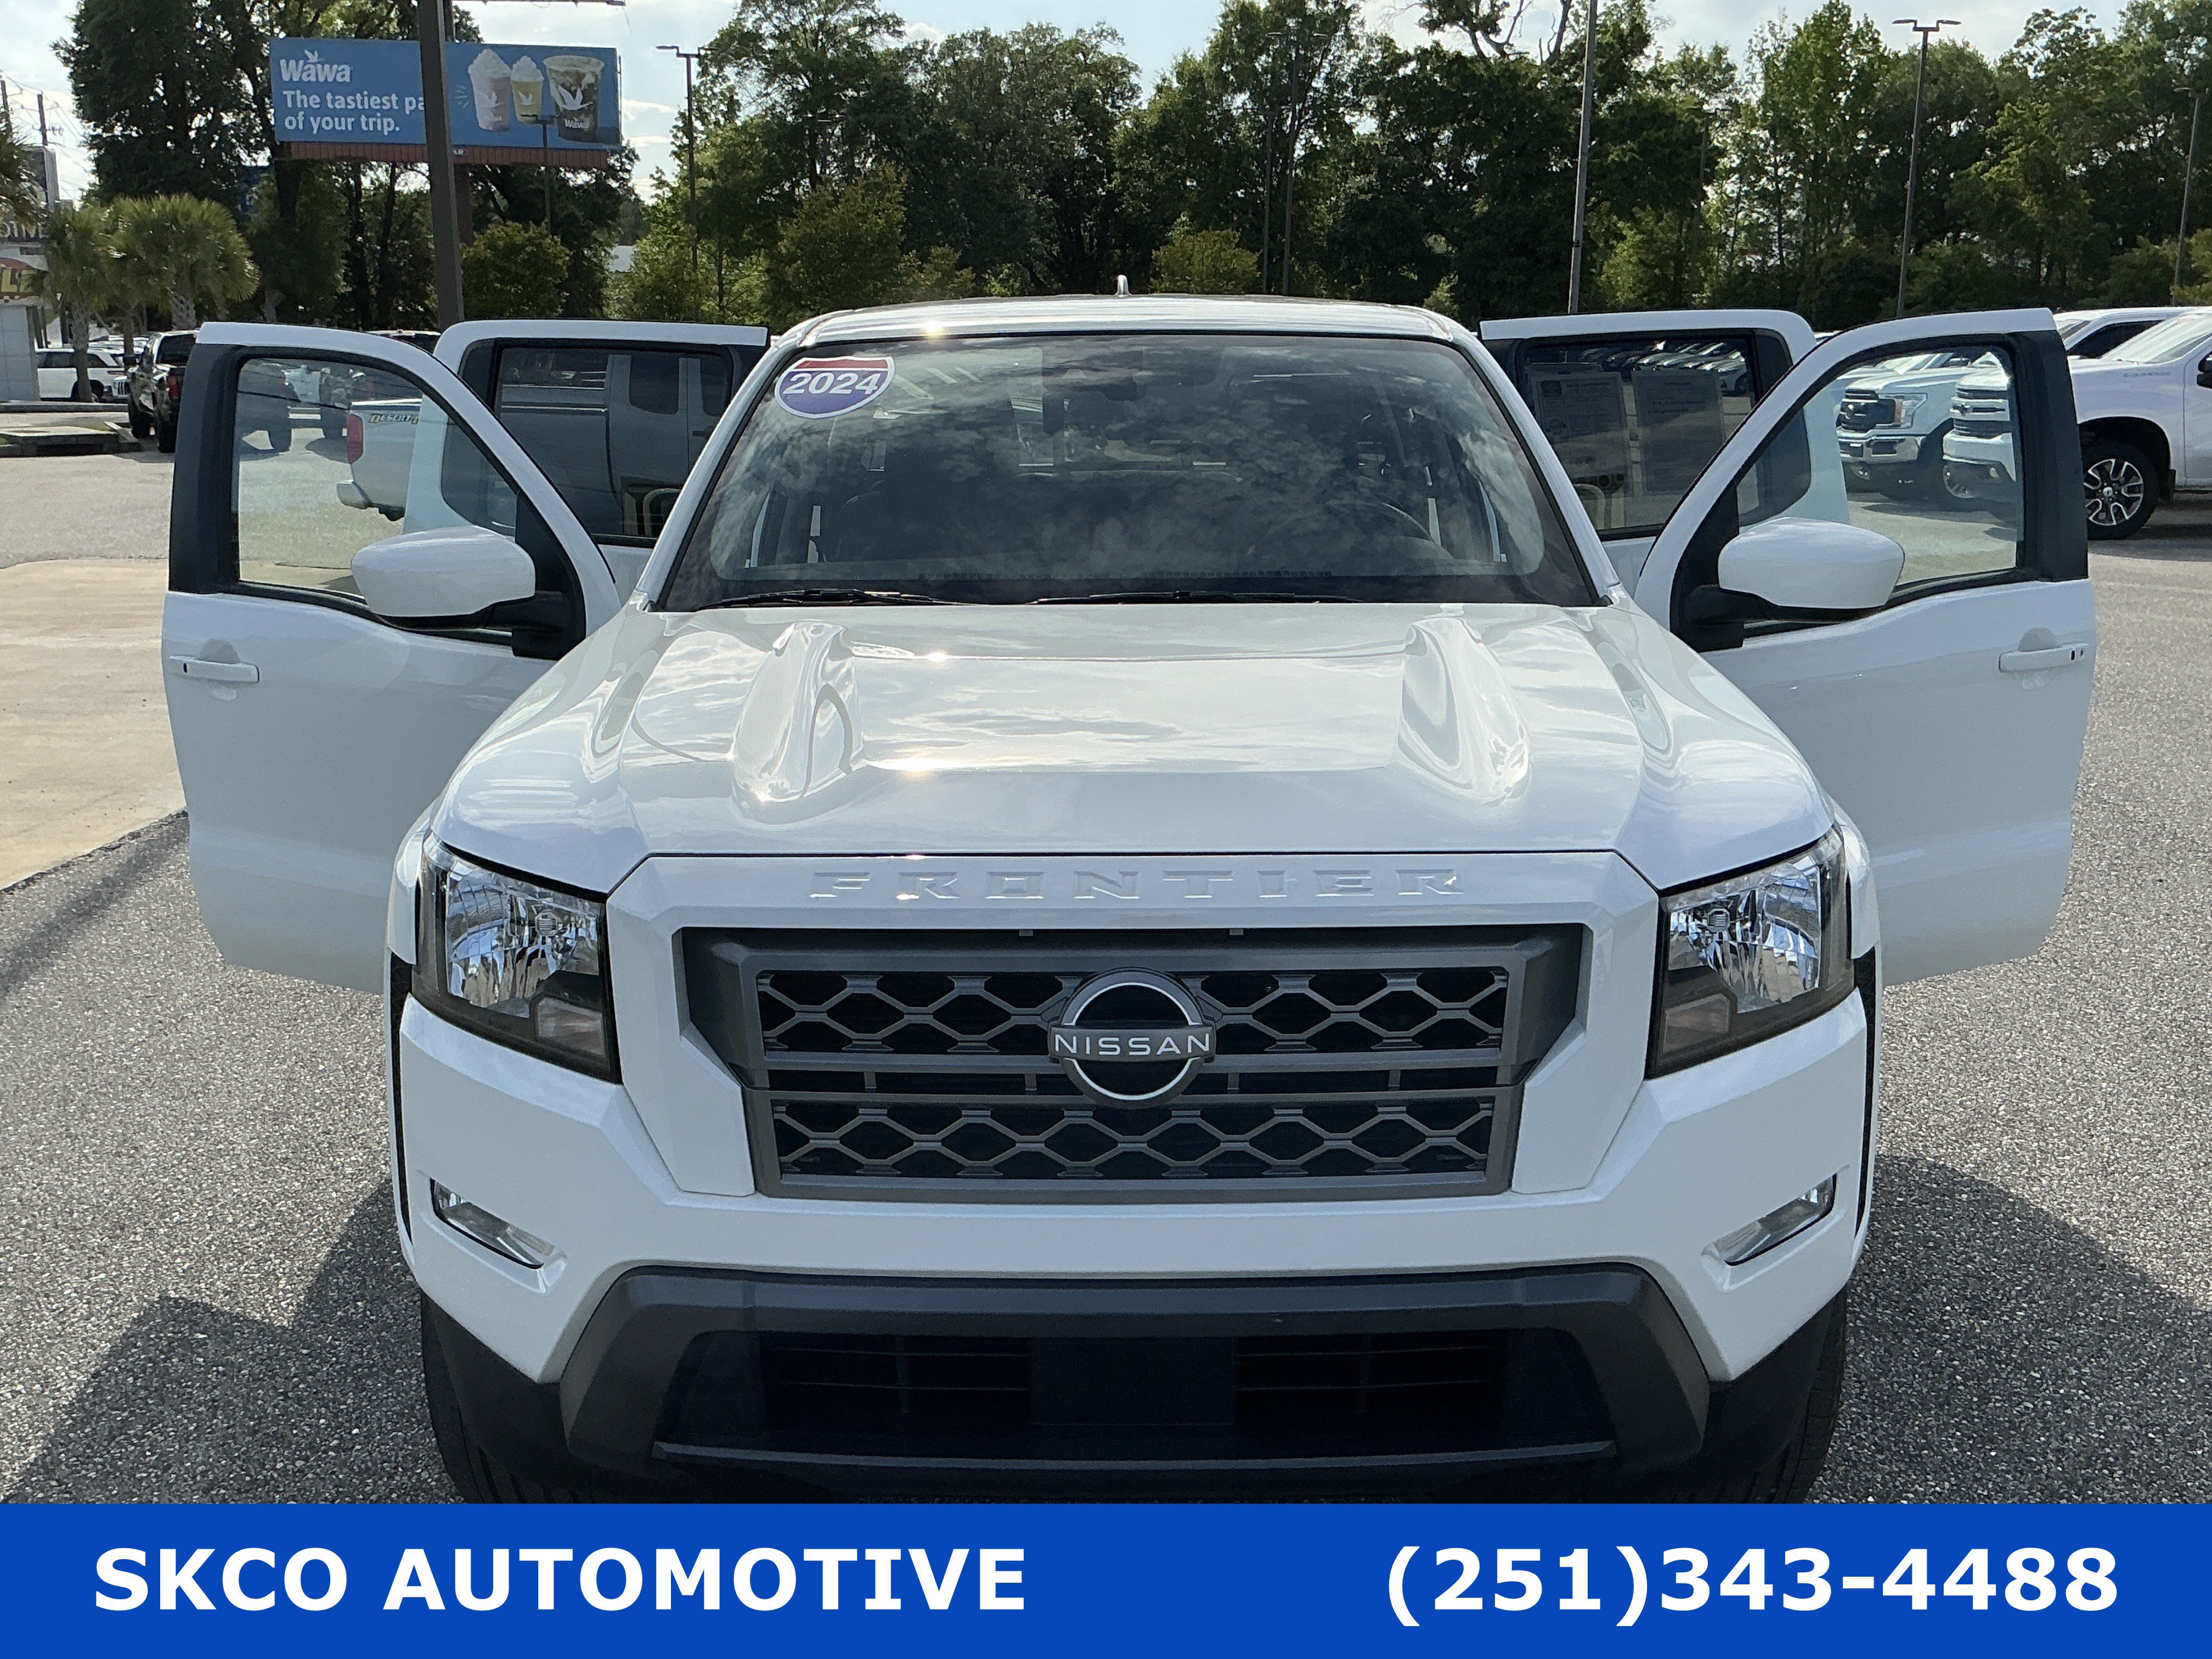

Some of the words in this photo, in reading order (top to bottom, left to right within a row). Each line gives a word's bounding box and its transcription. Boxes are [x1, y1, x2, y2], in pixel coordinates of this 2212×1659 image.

[280, 59, 351, 82] Wawa
[283, 89, 321, 109] The
[326, 91, 399, 110] tastiest
[405, 96, 425, 115] pa
[284, 111, 304, 130] of
[310, 116, 355, 134] your
[360, 112, 400, 136] trip.
[782, 372, 882, 395] 2024
[809, 868, 1464, 900] FRONTIER
[1054, 1033, 1210, 1056] NISSAN
